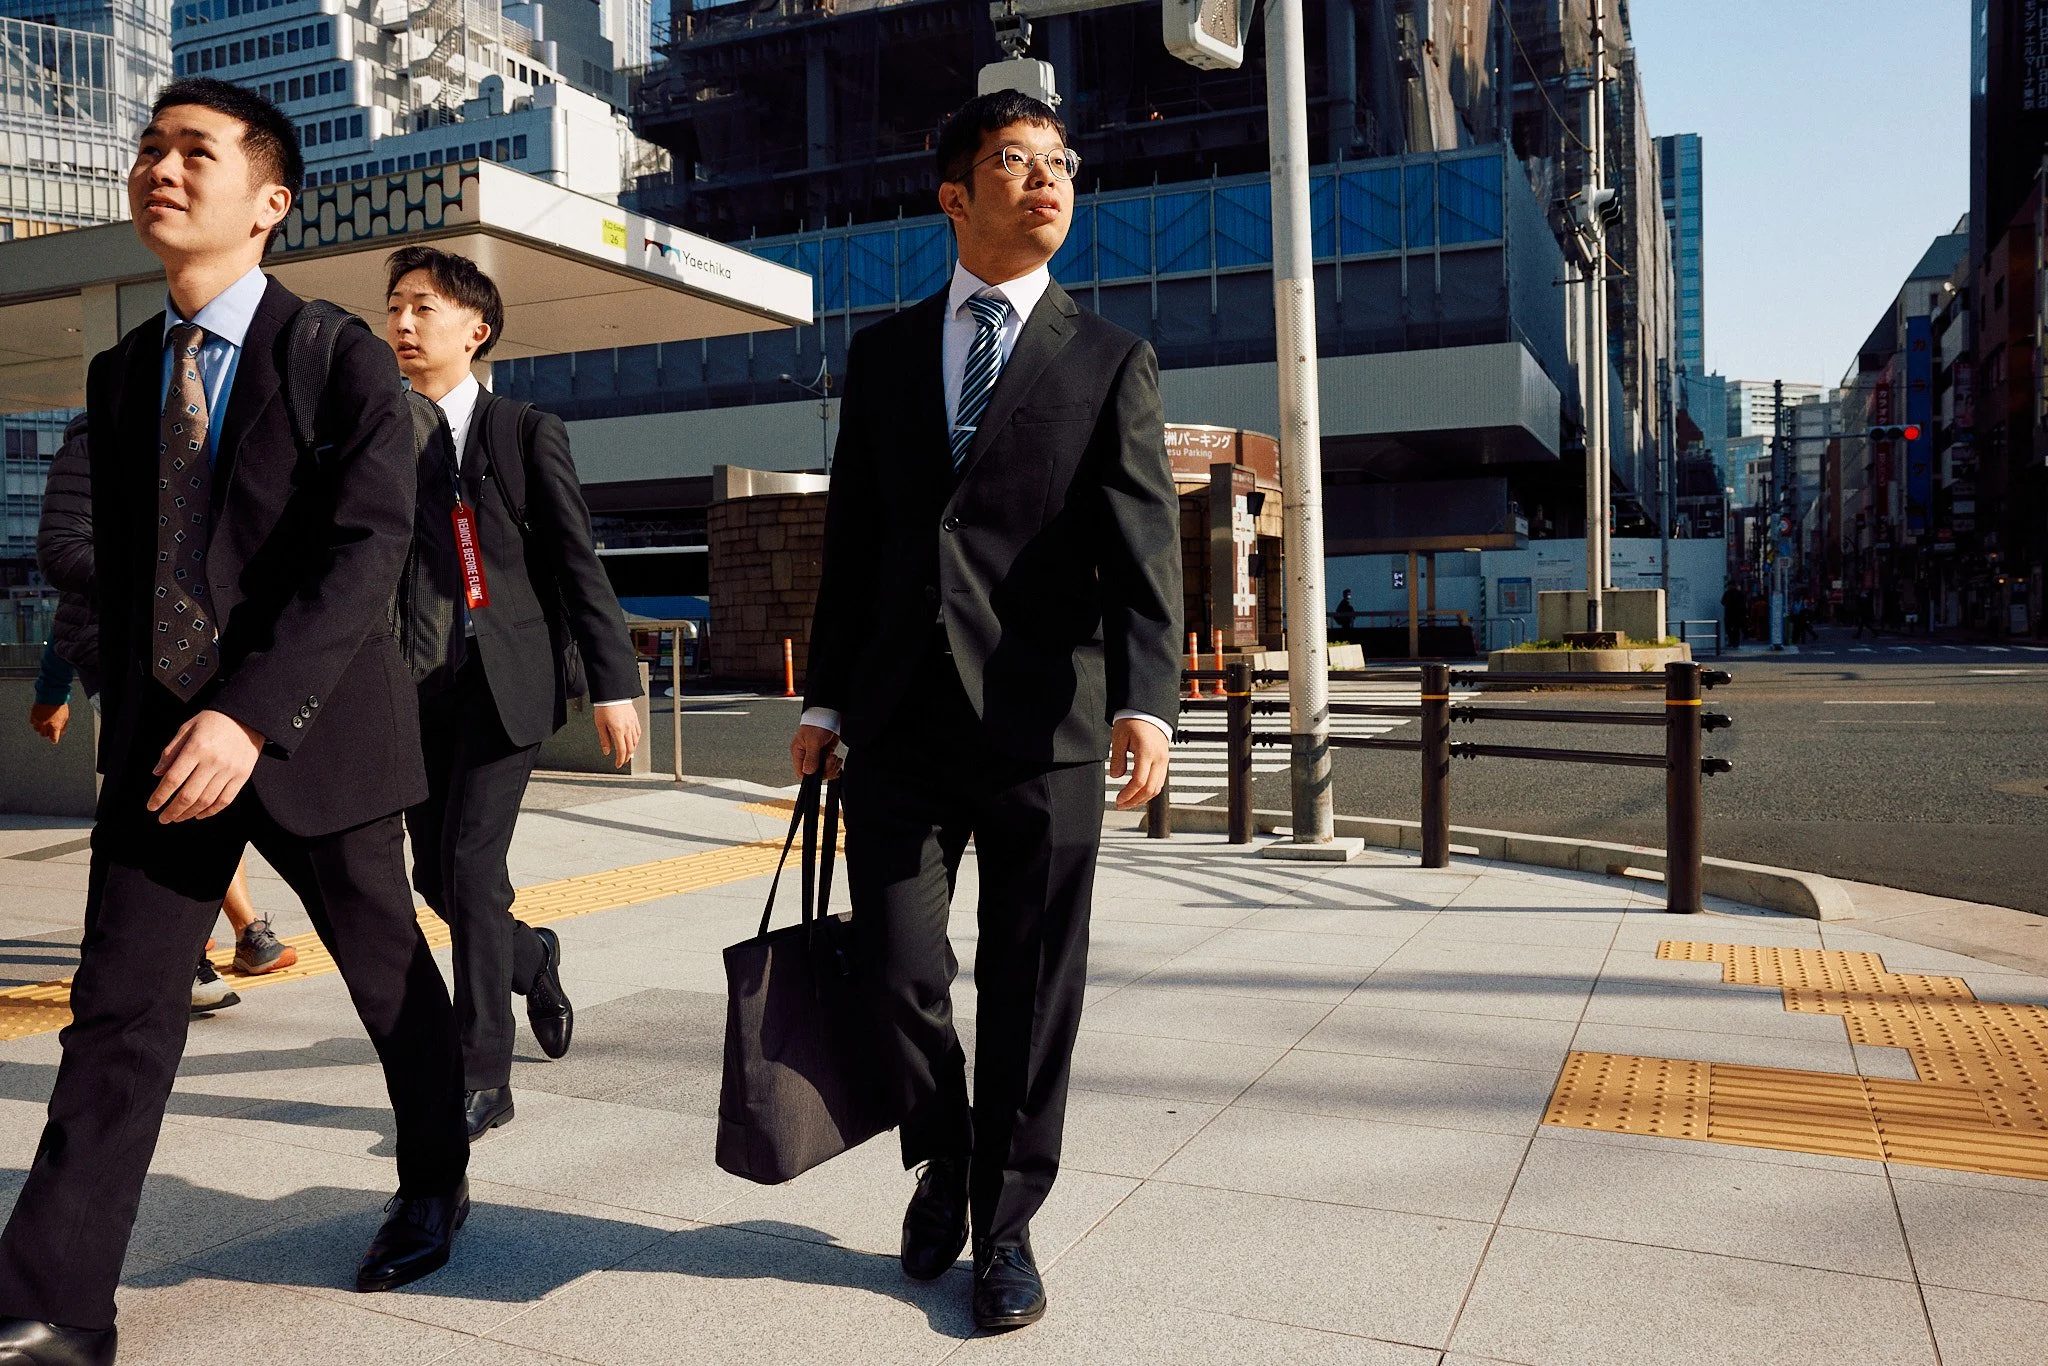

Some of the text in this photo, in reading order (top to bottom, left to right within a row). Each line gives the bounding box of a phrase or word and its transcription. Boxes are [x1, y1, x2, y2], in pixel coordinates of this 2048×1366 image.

[682, 250, 731, 279] Yaechika
[1183, 448, 1213, 459] Parking
[457, 518, 483, 600] REMOVE BEFORE FLIGHT
